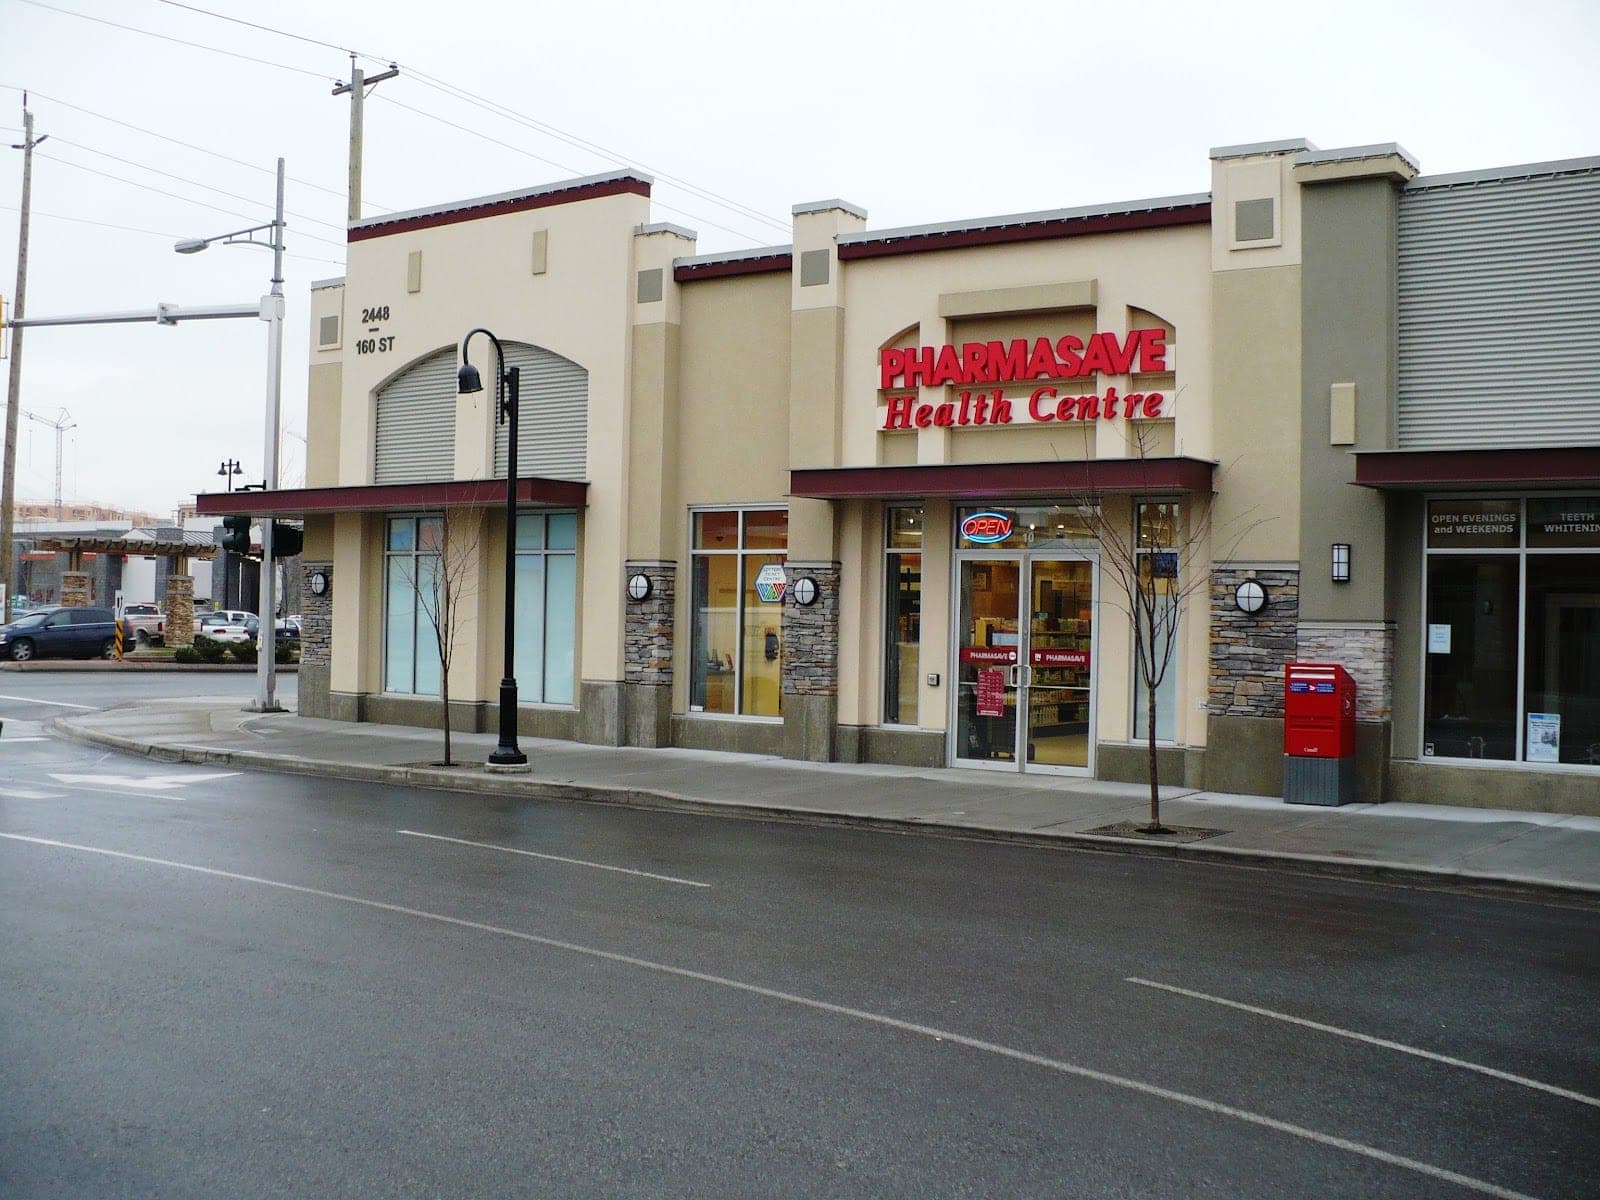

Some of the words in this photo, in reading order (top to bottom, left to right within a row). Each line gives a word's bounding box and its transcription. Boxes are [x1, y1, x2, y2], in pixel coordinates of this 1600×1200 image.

[361, 305, 390, 323] 2448
[356, 338, 375, 355] 160
[378, 336, 395, 353] ST
[880, 328, 1166, 389] PHARMASAVE
[882, 388, 1013, 430] Health
[1028, 386, 1165, 422] Centre
[1431, 514, 1460, 524] OPEN
[1462, 513, 1517, 523] EVENINGS
[1559, 513, 1595, 521] TEETH
[964, 519, 1012, 535] OPEN
[1434, 524, 1453, 534] and
[1456, 524, 1514, 533] WEEKENDS
[970, 651, 1008, 660] PHARMASAVE
[1045, 654, 1086, 663] PHARMASAVE
